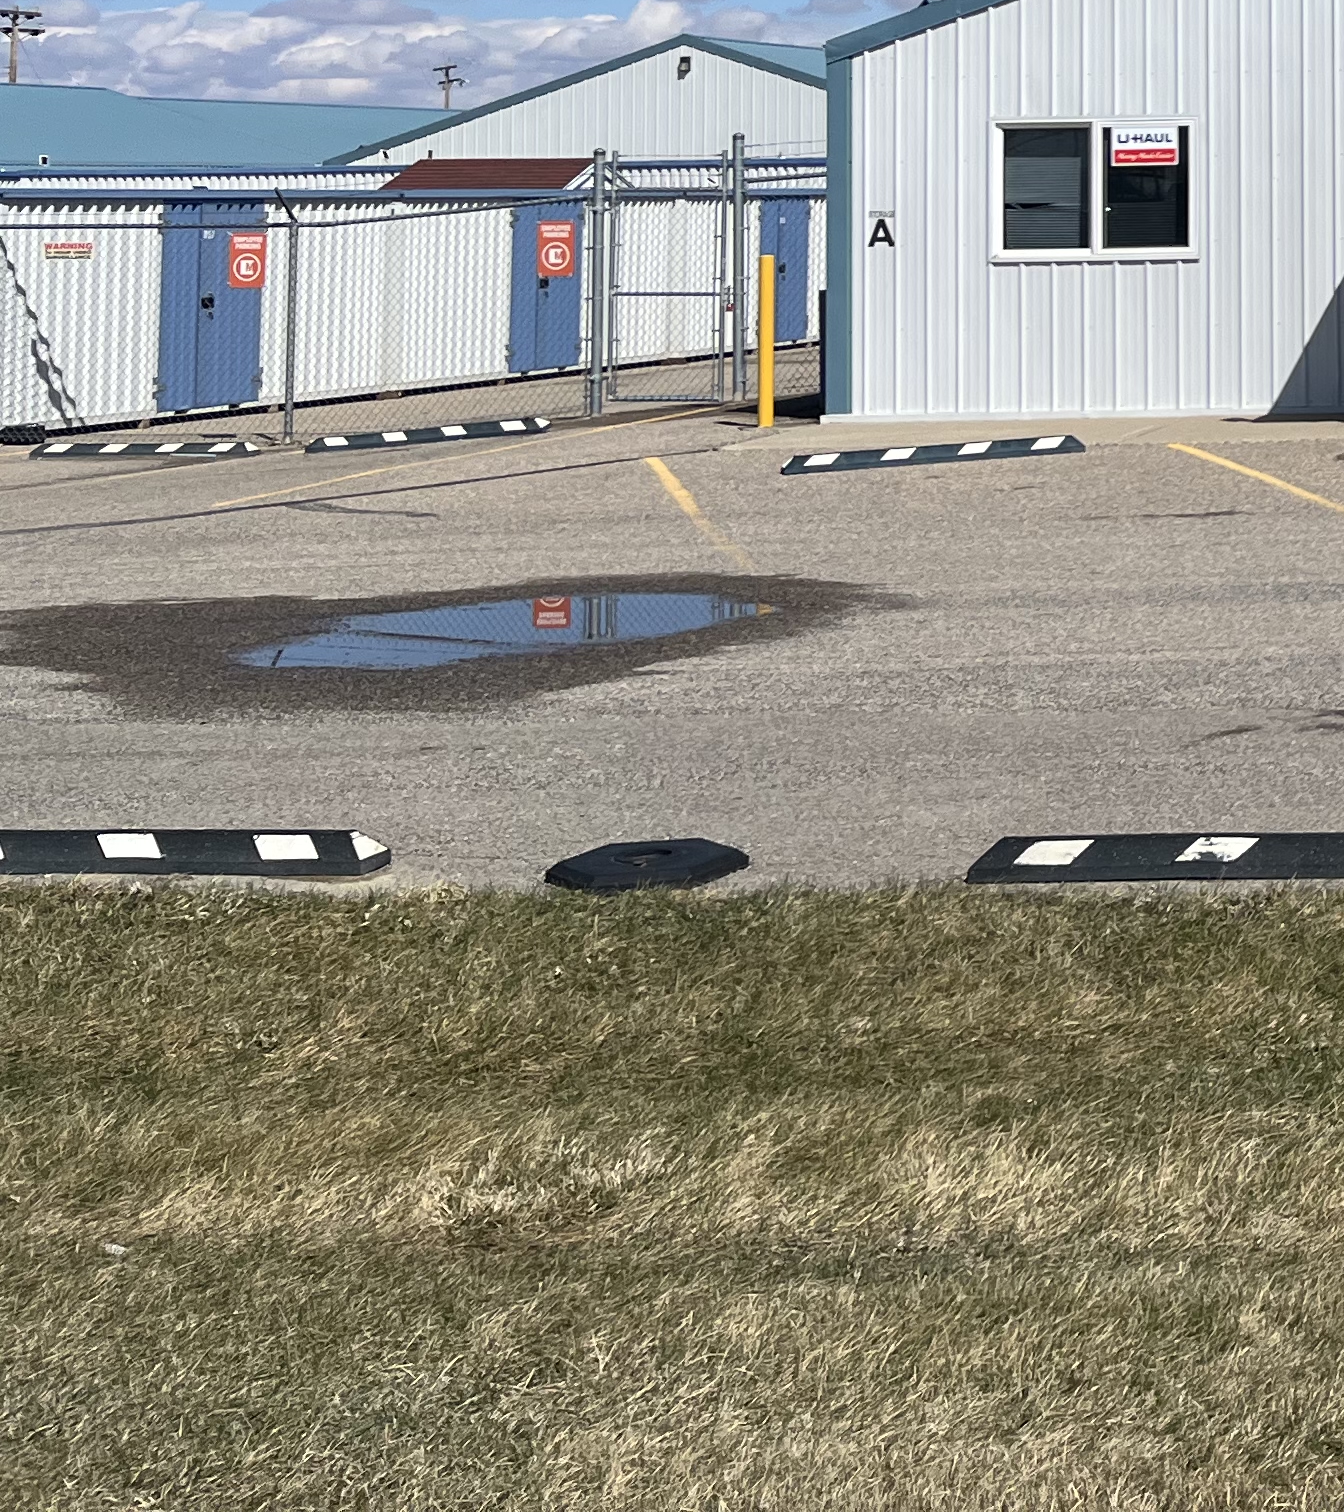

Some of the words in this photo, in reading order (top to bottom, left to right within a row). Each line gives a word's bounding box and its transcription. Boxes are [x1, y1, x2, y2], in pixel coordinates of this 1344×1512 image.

[1117, 133, 1173, 144] U-HAUL
[867, 218, 896, 248] A
[44, 242, 94, 250] WARNING
